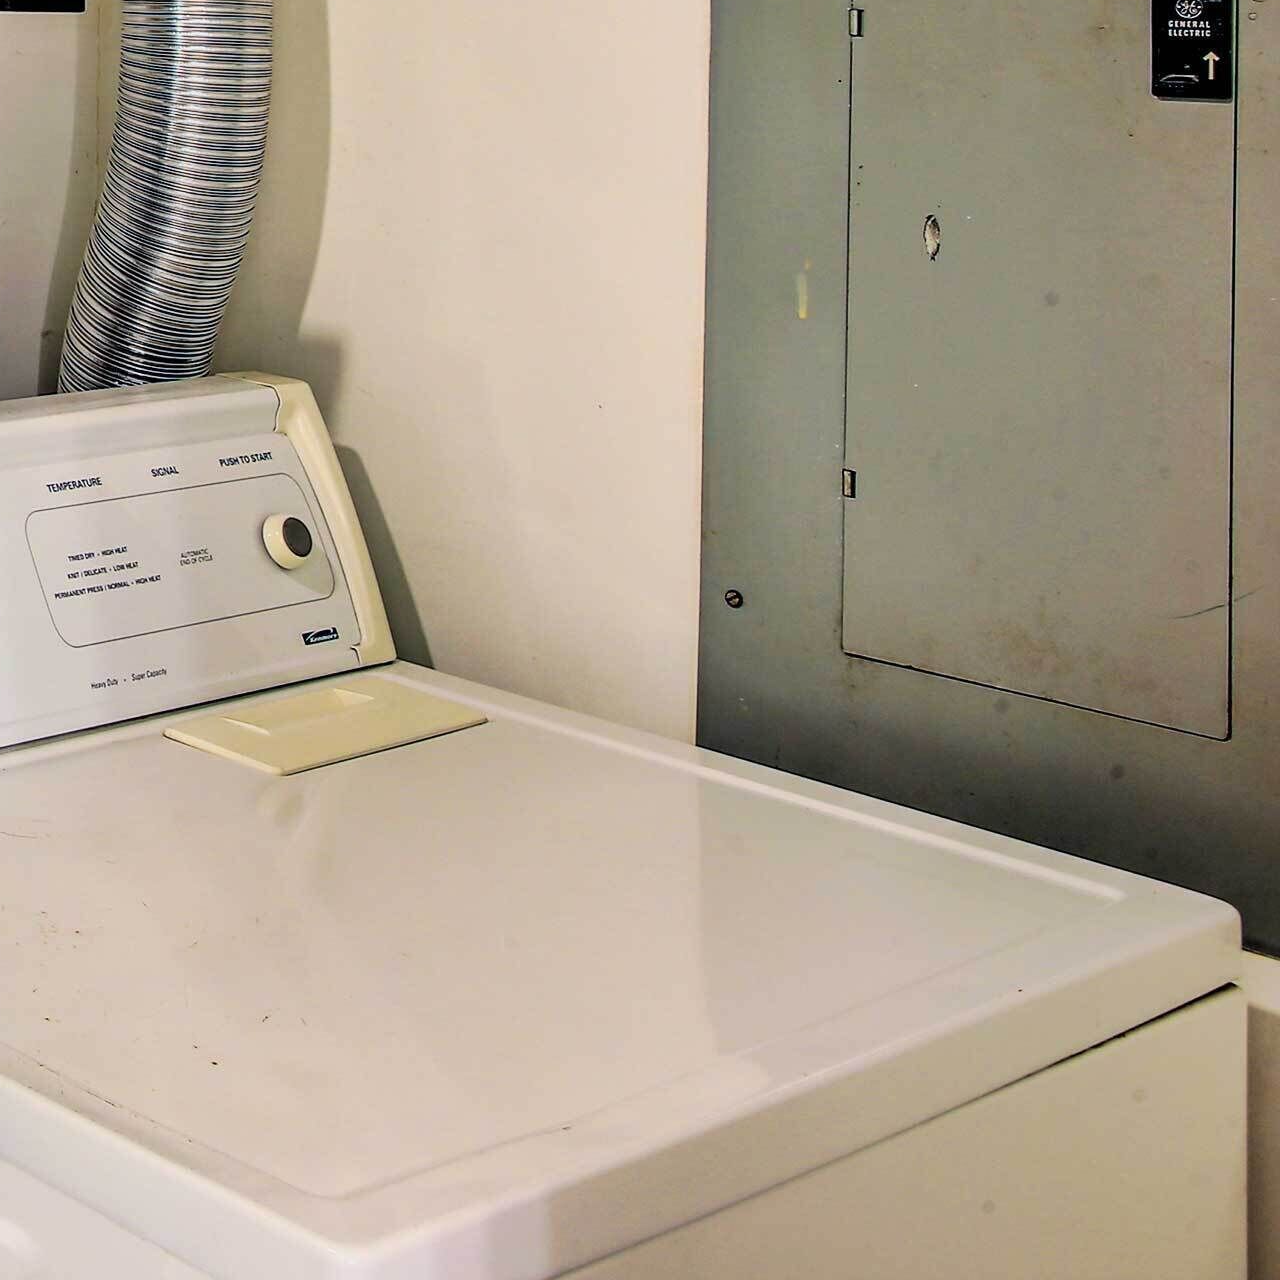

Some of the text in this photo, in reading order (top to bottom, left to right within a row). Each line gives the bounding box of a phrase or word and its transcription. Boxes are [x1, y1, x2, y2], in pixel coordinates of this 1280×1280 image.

[1168, 20, 1211, 28] GENERAL
[1168, 29, 1211, 37] ELECTRIC
[47, 452, 273, 493] TEMPERATURE SIGNAL PUSH TO START
[85, 552, 95, 560] DRY
[115, 546, 128, 554] HEAT
[84, 567, 107, 577] DELICATE
[113, 564, 126, 572] LOW
[126, 561, 139, 569] HEAT
[54, 589, 86, 599] PERMANENT
[87, 586, 104, 594] PRESS
[107, 581, 130, 590] NORMAL
